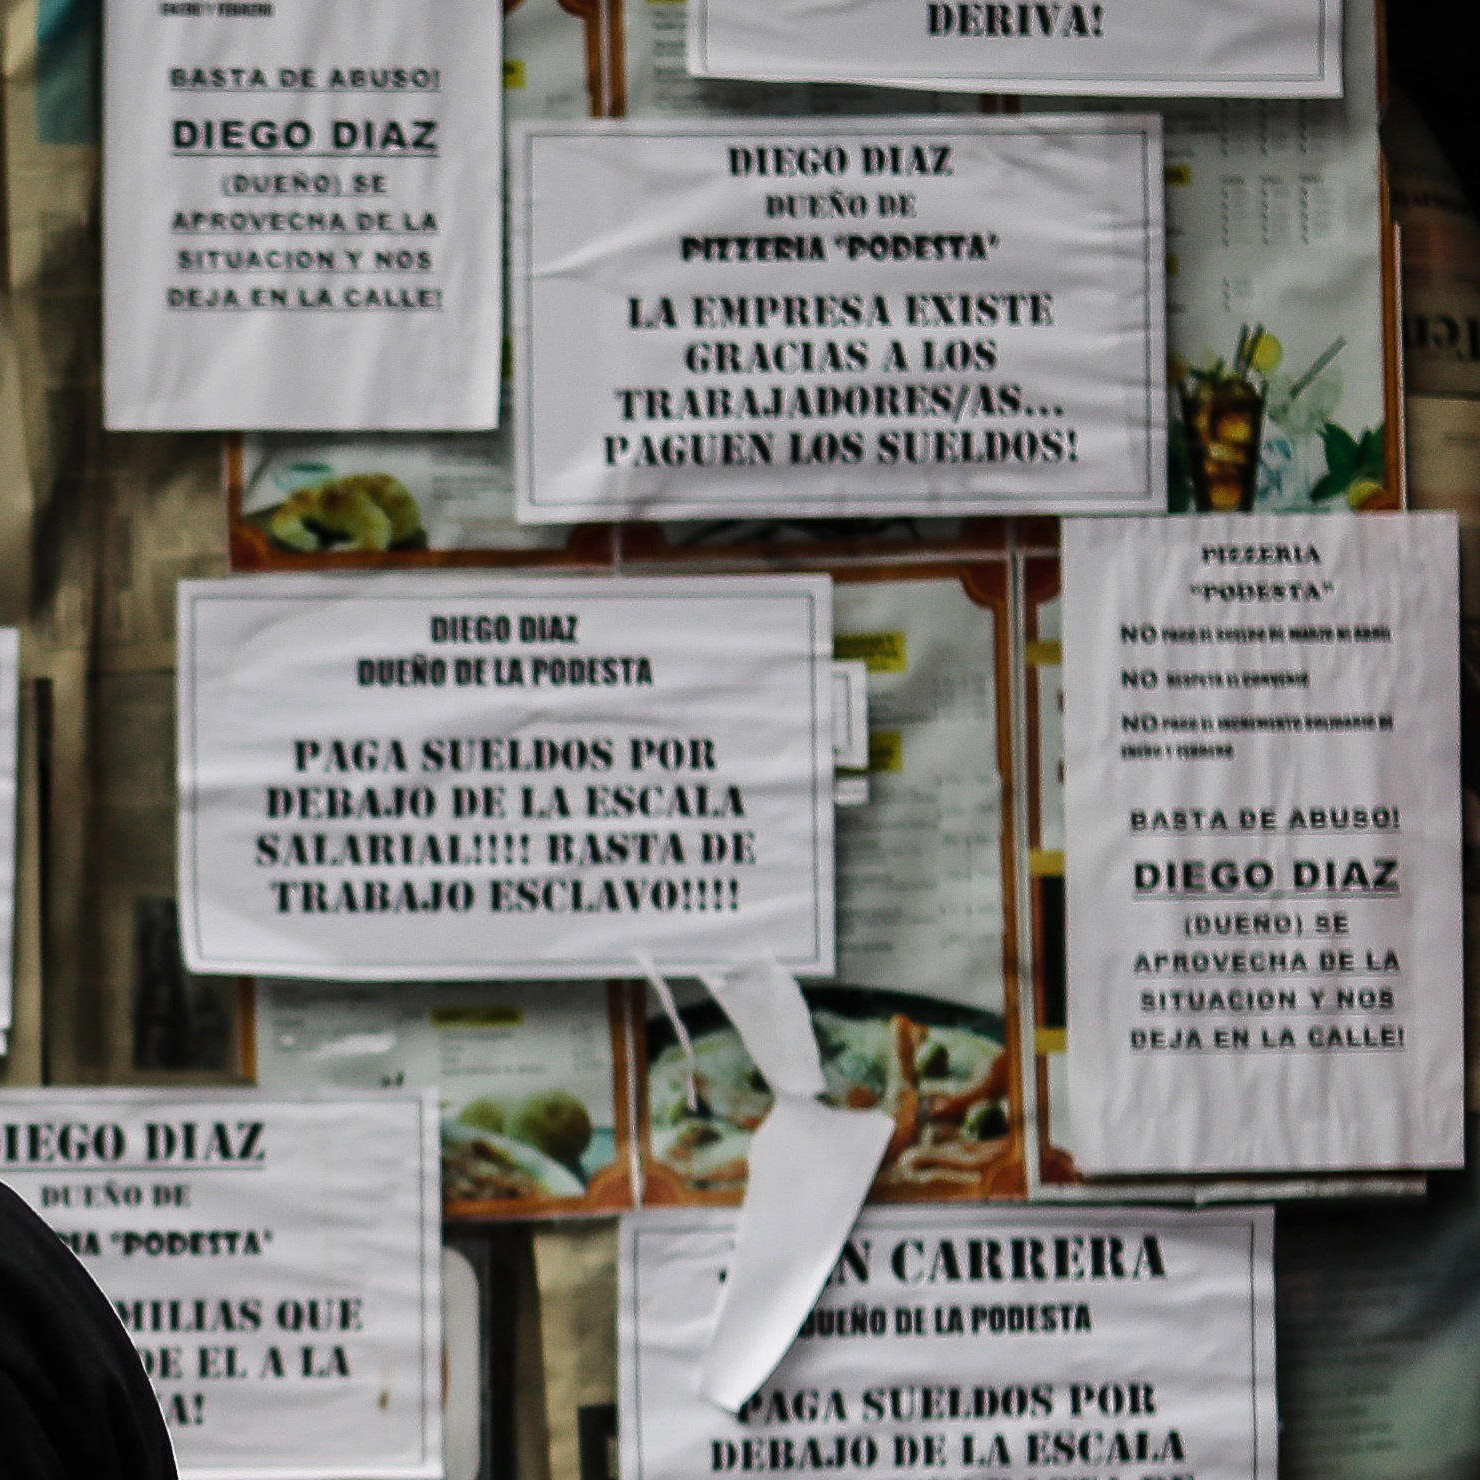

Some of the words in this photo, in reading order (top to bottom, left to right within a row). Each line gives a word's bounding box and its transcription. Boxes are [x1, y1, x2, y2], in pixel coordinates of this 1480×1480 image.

[926, 2, 1104, 37] DERIVA!
[171, 119, 313, 151] DIEGO
[330, 119, 439, 153] DIAZ
[627, 296, 678, 329] LA
[691, 293, 892, 328] EMPRESA
[903, 291, 1054, 326] EXISTE
[683, 340, 870, 374] GRACIAS
[886, 340, 912, 372] A
[921, 340, 999, 372] LOS
[603, 432, 774, 469] PAGUEN
[787, 431, 866, 467] LOS
[875, 430, 1079, 467] SUELDOS!
[429, 614, 513, 644] DIEGO
[517, 614, 579, 644] DIAZ
[355, 653, 449, 687] DUEÑO
[452, 656, 488, 687] DE
[491, 656, 526, 687] LA
[529, 656, 654, 687] PODESTA
[1133, 859, 1275, 893] DIEGO
[1291, 859, 1401, 892] DIAZ
[144, 1121, 266, 1162] DIAZ
[889, 1230, 1172, 1282] CARRERA
